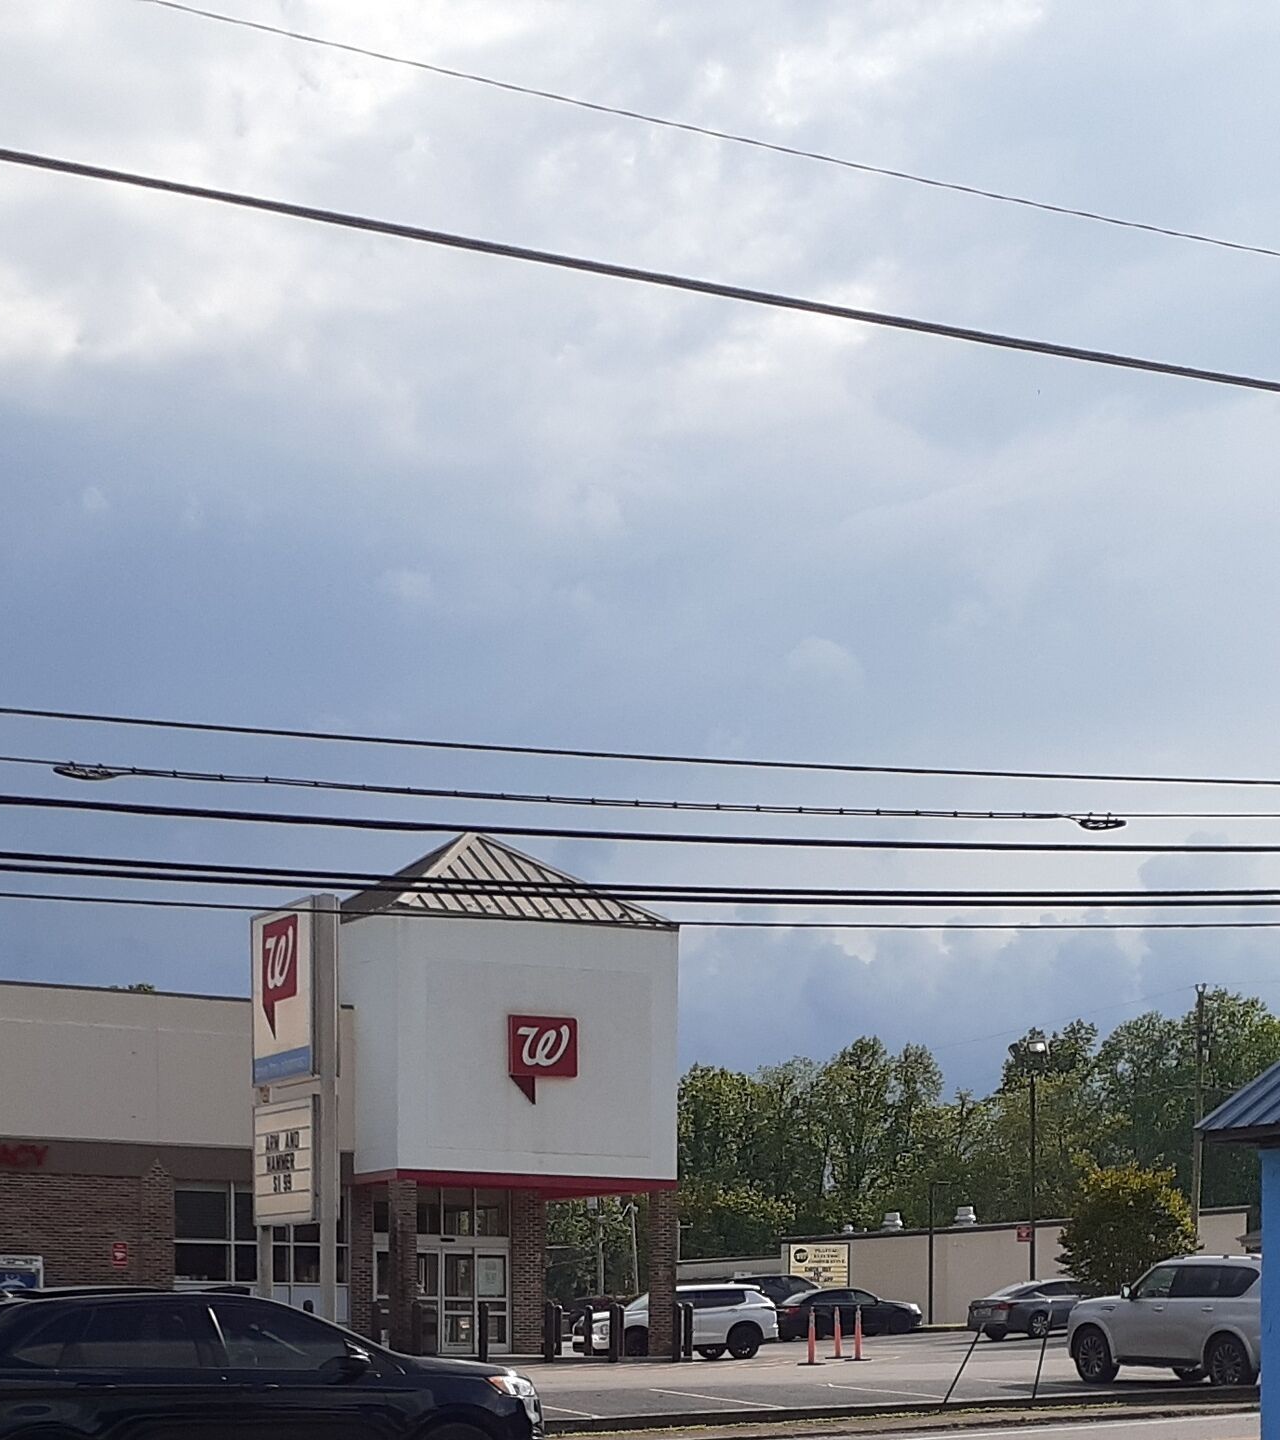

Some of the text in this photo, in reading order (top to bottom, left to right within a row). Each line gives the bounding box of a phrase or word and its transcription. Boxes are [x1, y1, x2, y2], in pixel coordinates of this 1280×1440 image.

[265, 924, 294, 990] W
[517, 1024, 570, 1067] W
[285, 1131, 300, 1149] AND
[266, 1152, 295, 1173] HAMMER
